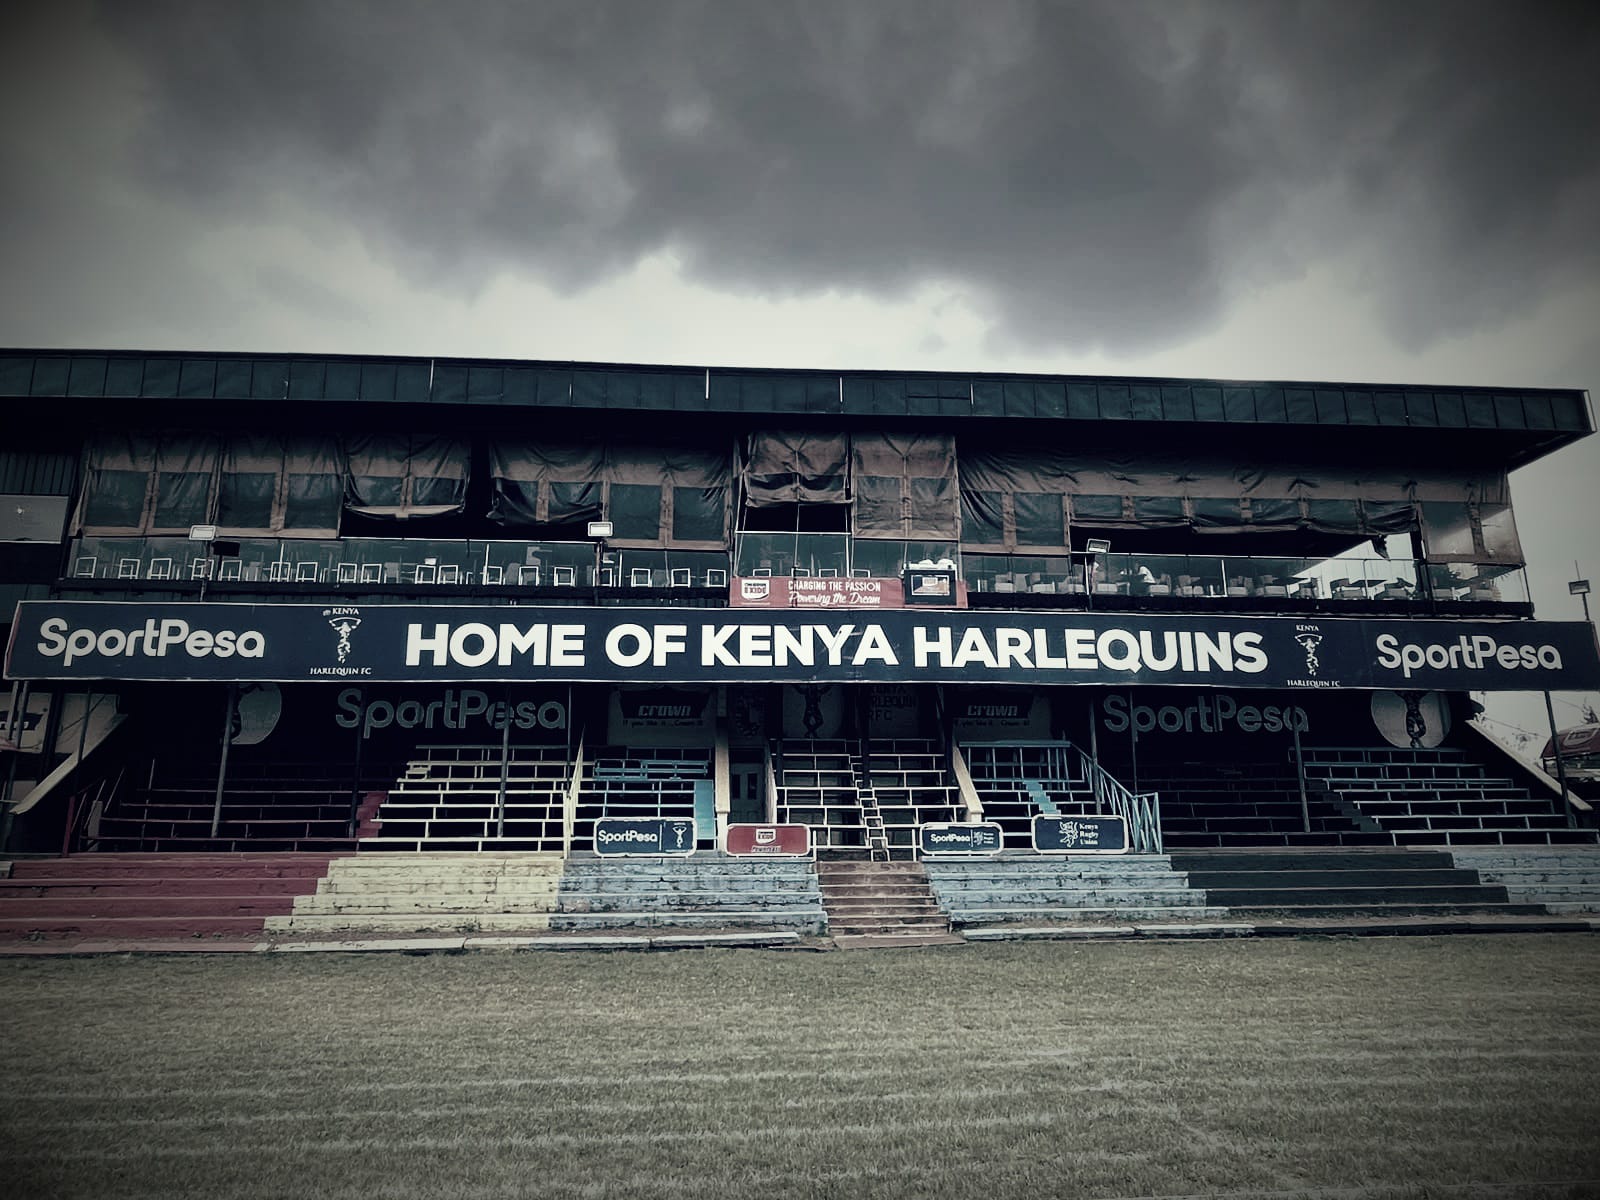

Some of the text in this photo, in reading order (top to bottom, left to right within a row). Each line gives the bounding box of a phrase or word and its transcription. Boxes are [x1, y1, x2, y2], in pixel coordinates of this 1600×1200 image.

[788, 581, 881, 592] CHARGING THE PASSION
[788, 591, 881, 606] Powering the Dream
[332, 607, 359, 615] KENYA
[1295, 624, 1320, 632] KENYA
[37, 617, 266, 667] SportPesa
[405, 622, 1269, 674] HOME OF KENYA HARLEQUINS
[1376, 633, 1564, 678] SportPesa
[309, 667, 372, 676] HARLEQUIN FC
[1287, 679, 1330, 688] HARLEQUIN
[335, 688, 566, 739] SportPesa
[1103, 694, 1309, 743] SportPesa
[1079, 823, 1099, 831] Kenya
[598, 829, 658, 845] SportPesa
[930, 833, 971, 844] SportPesa
